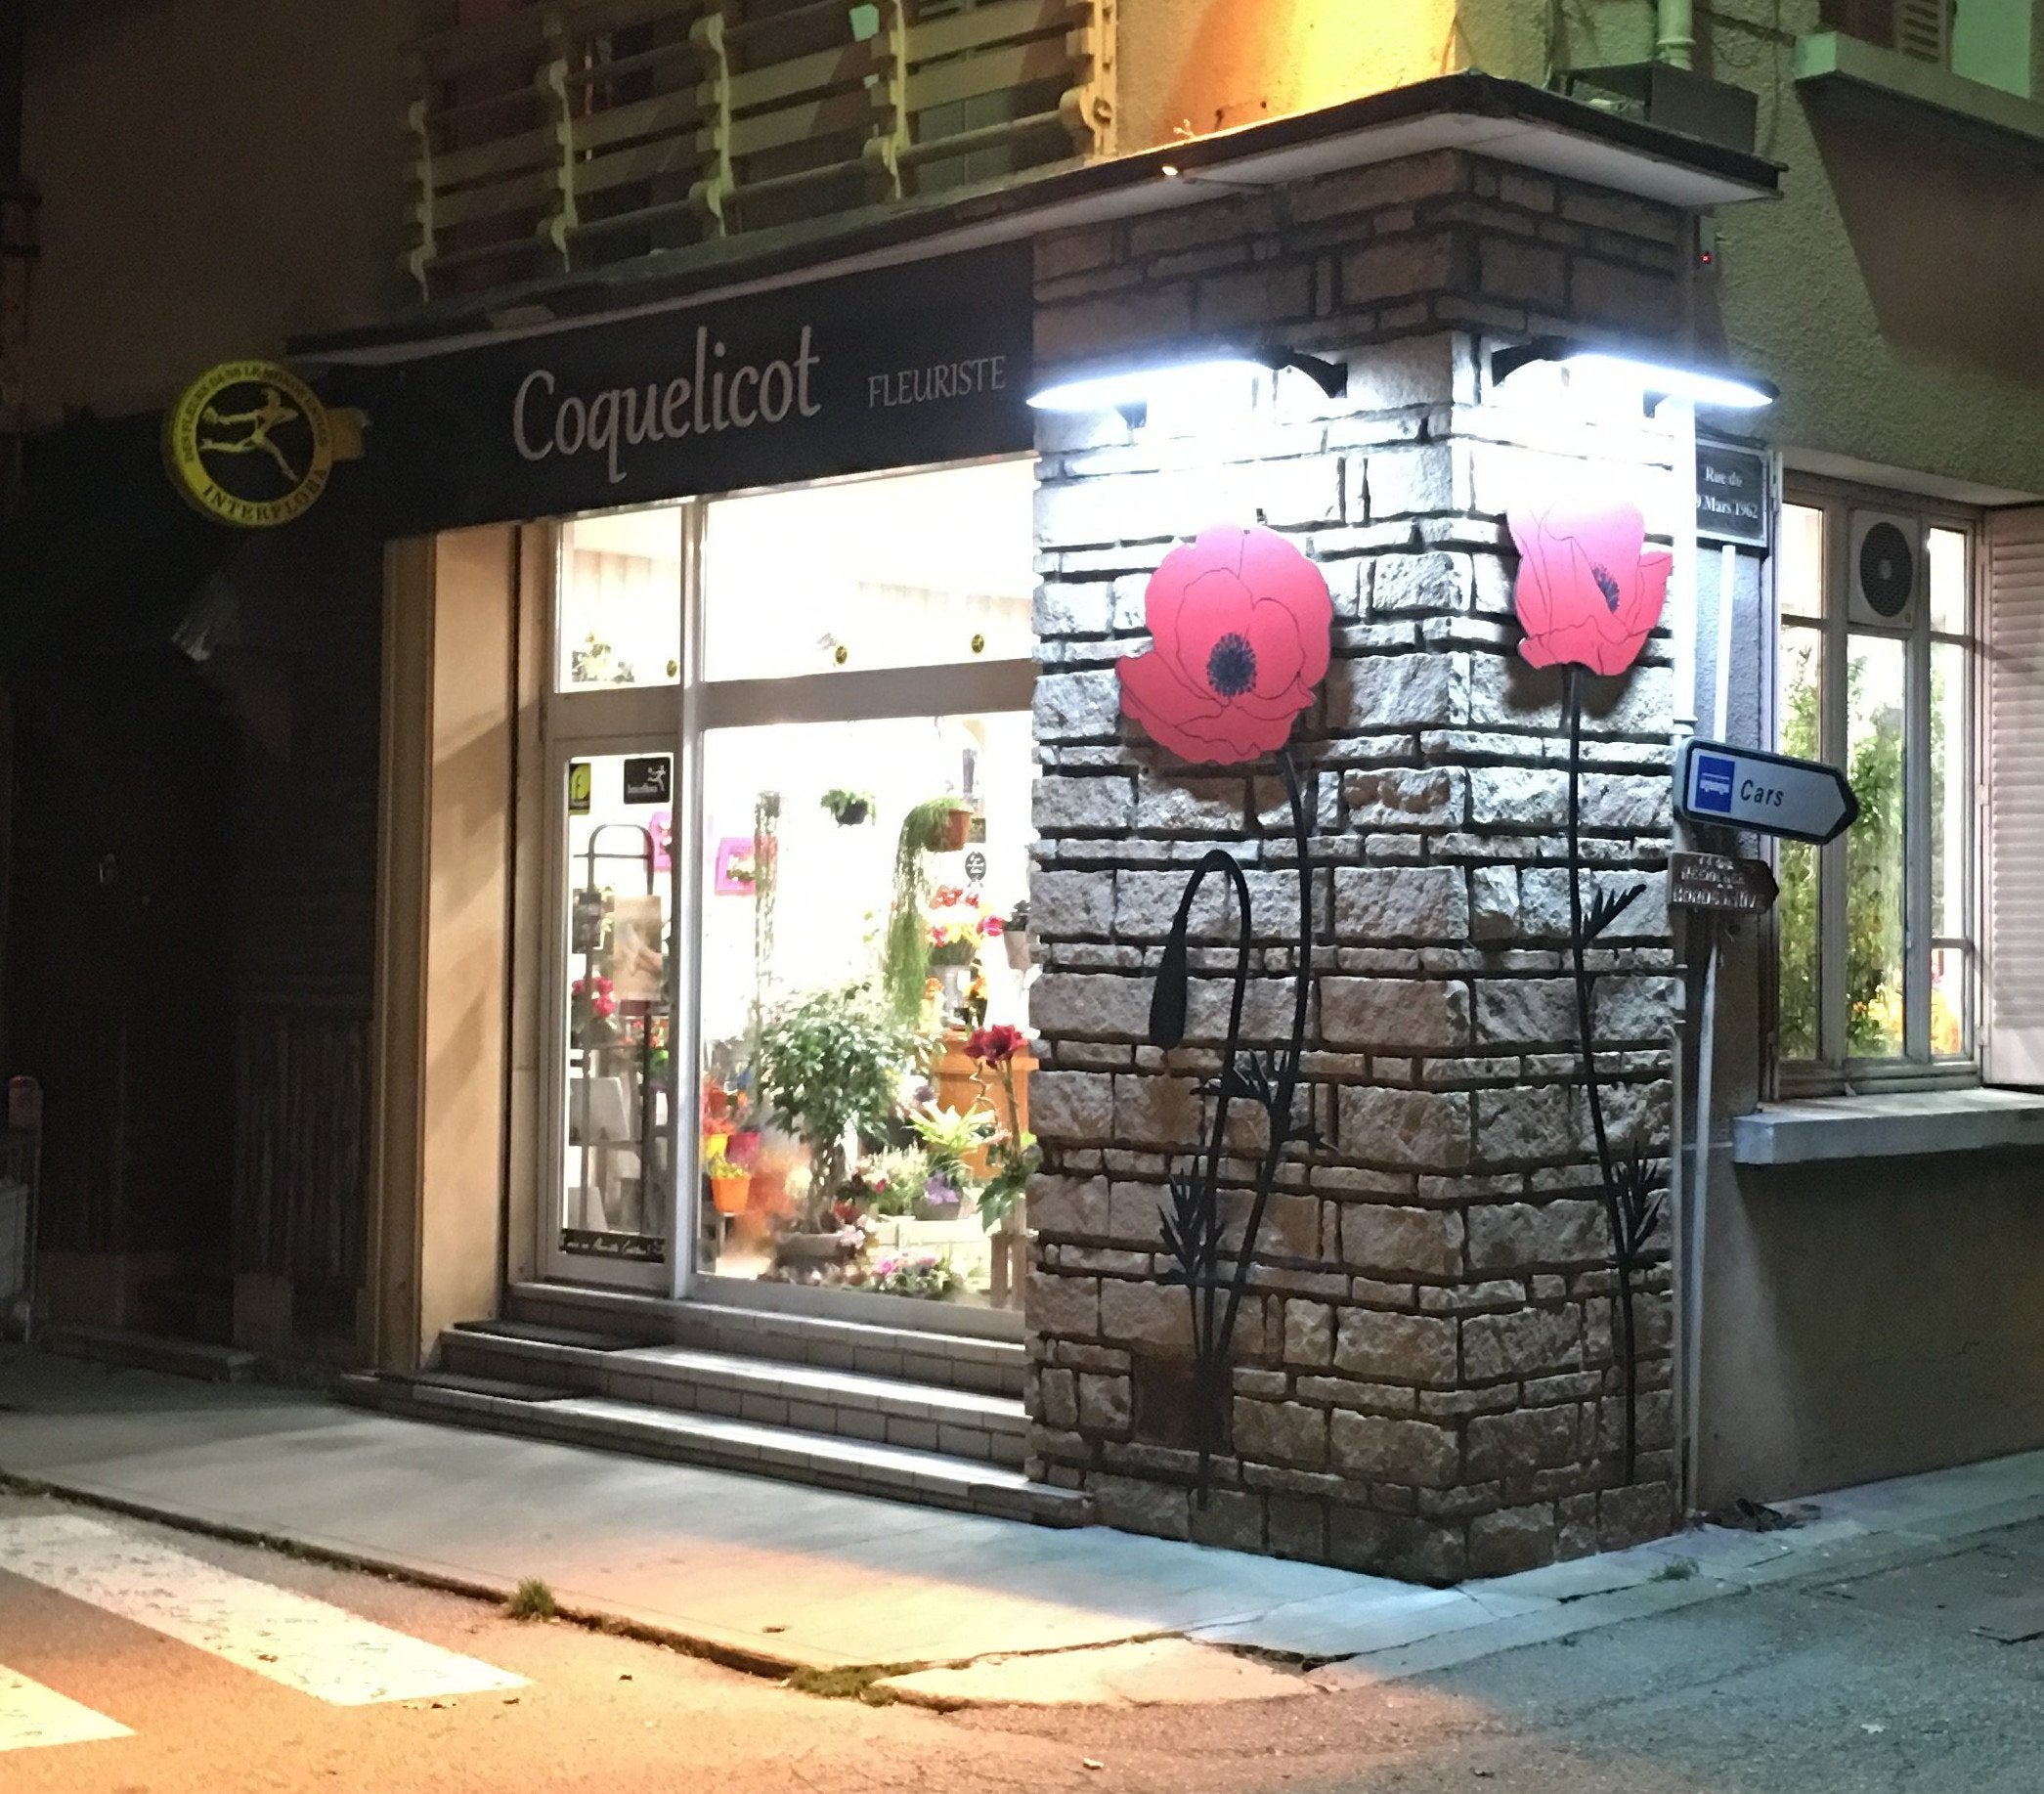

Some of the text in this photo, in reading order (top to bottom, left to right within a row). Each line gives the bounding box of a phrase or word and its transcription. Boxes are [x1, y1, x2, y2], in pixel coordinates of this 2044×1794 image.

[513, 326, 1006, 484] Coquelicot FLEURISTE
[1705, 465, 1725, 485] Rue
[202, 468, 327, 520] INTERFLORA
[1702, 495, 1731, 513] Mars
[1735, 503, 1759, 519] 1962
[1741, 779, 1784, 808] Cars
